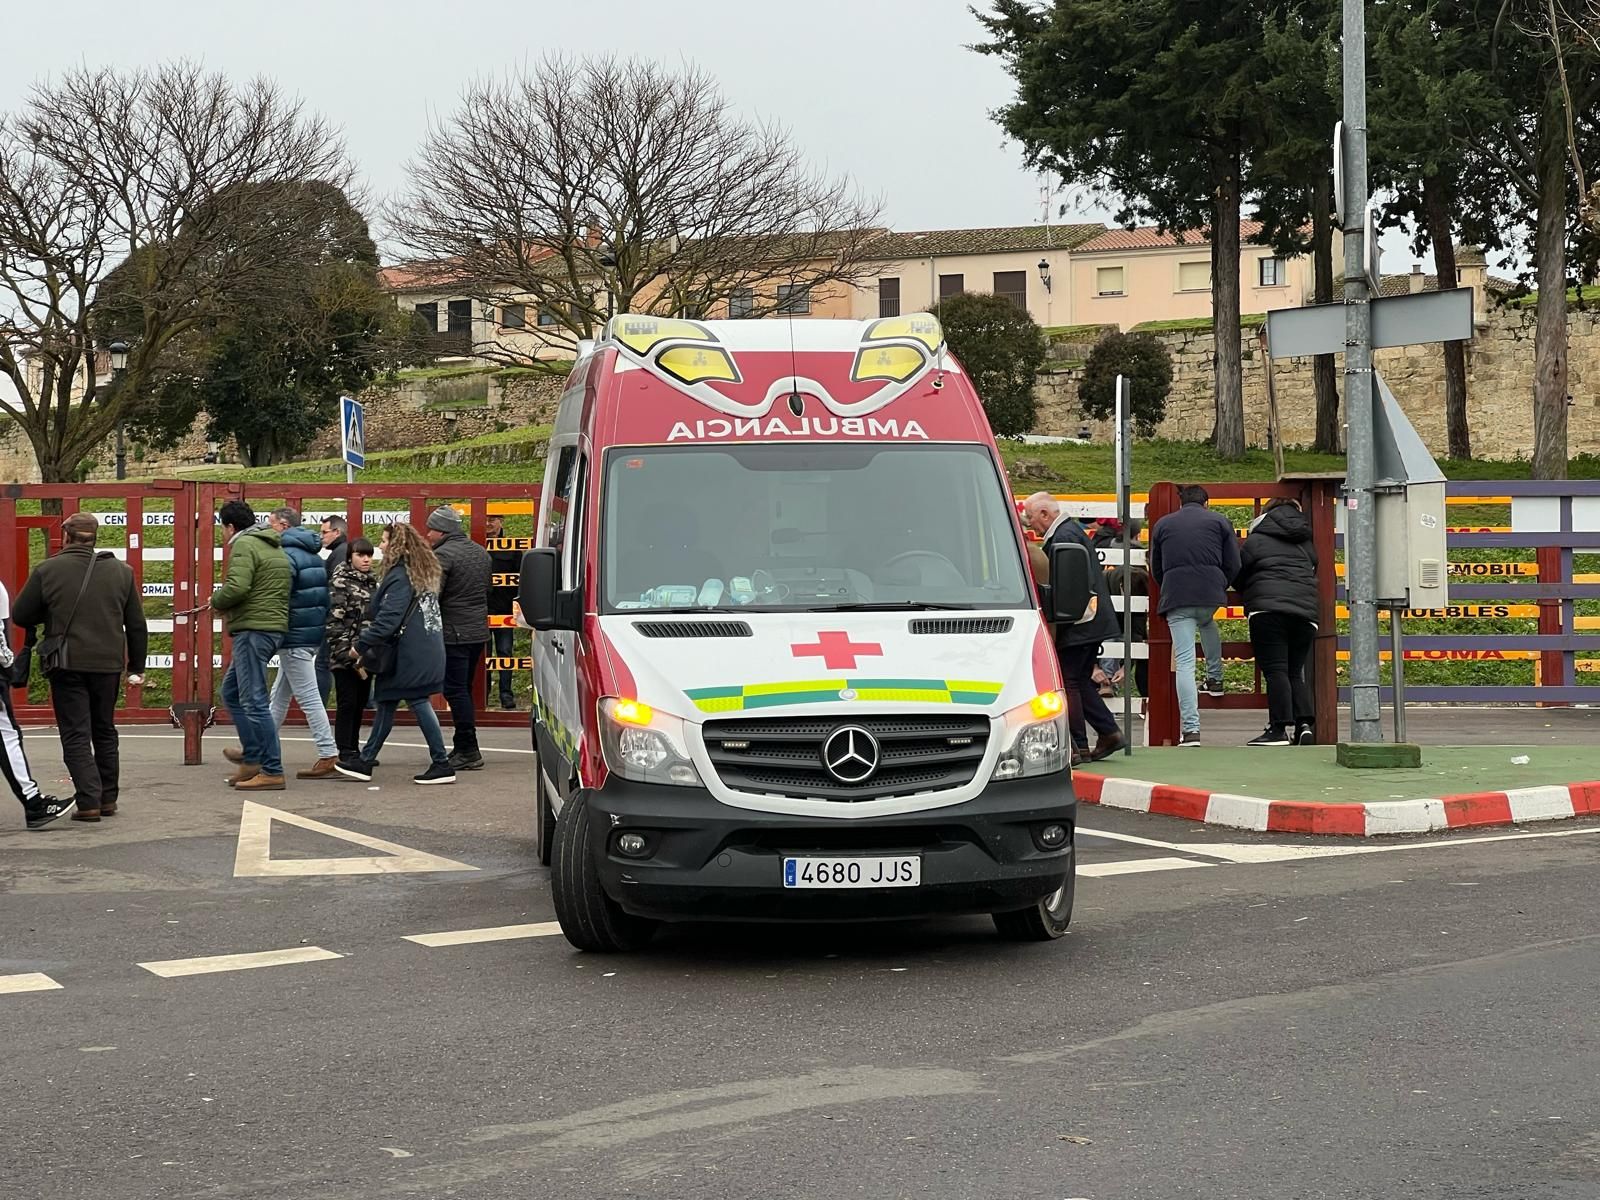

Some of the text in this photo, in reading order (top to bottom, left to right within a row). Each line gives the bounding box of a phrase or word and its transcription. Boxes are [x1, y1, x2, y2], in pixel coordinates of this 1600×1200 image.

[147, 515, 159, 524] DE
[142, 585, 173, 594] ORMAT
[801, 862, 861, 883] 4680
[870, 861, 912, 883] JJS
